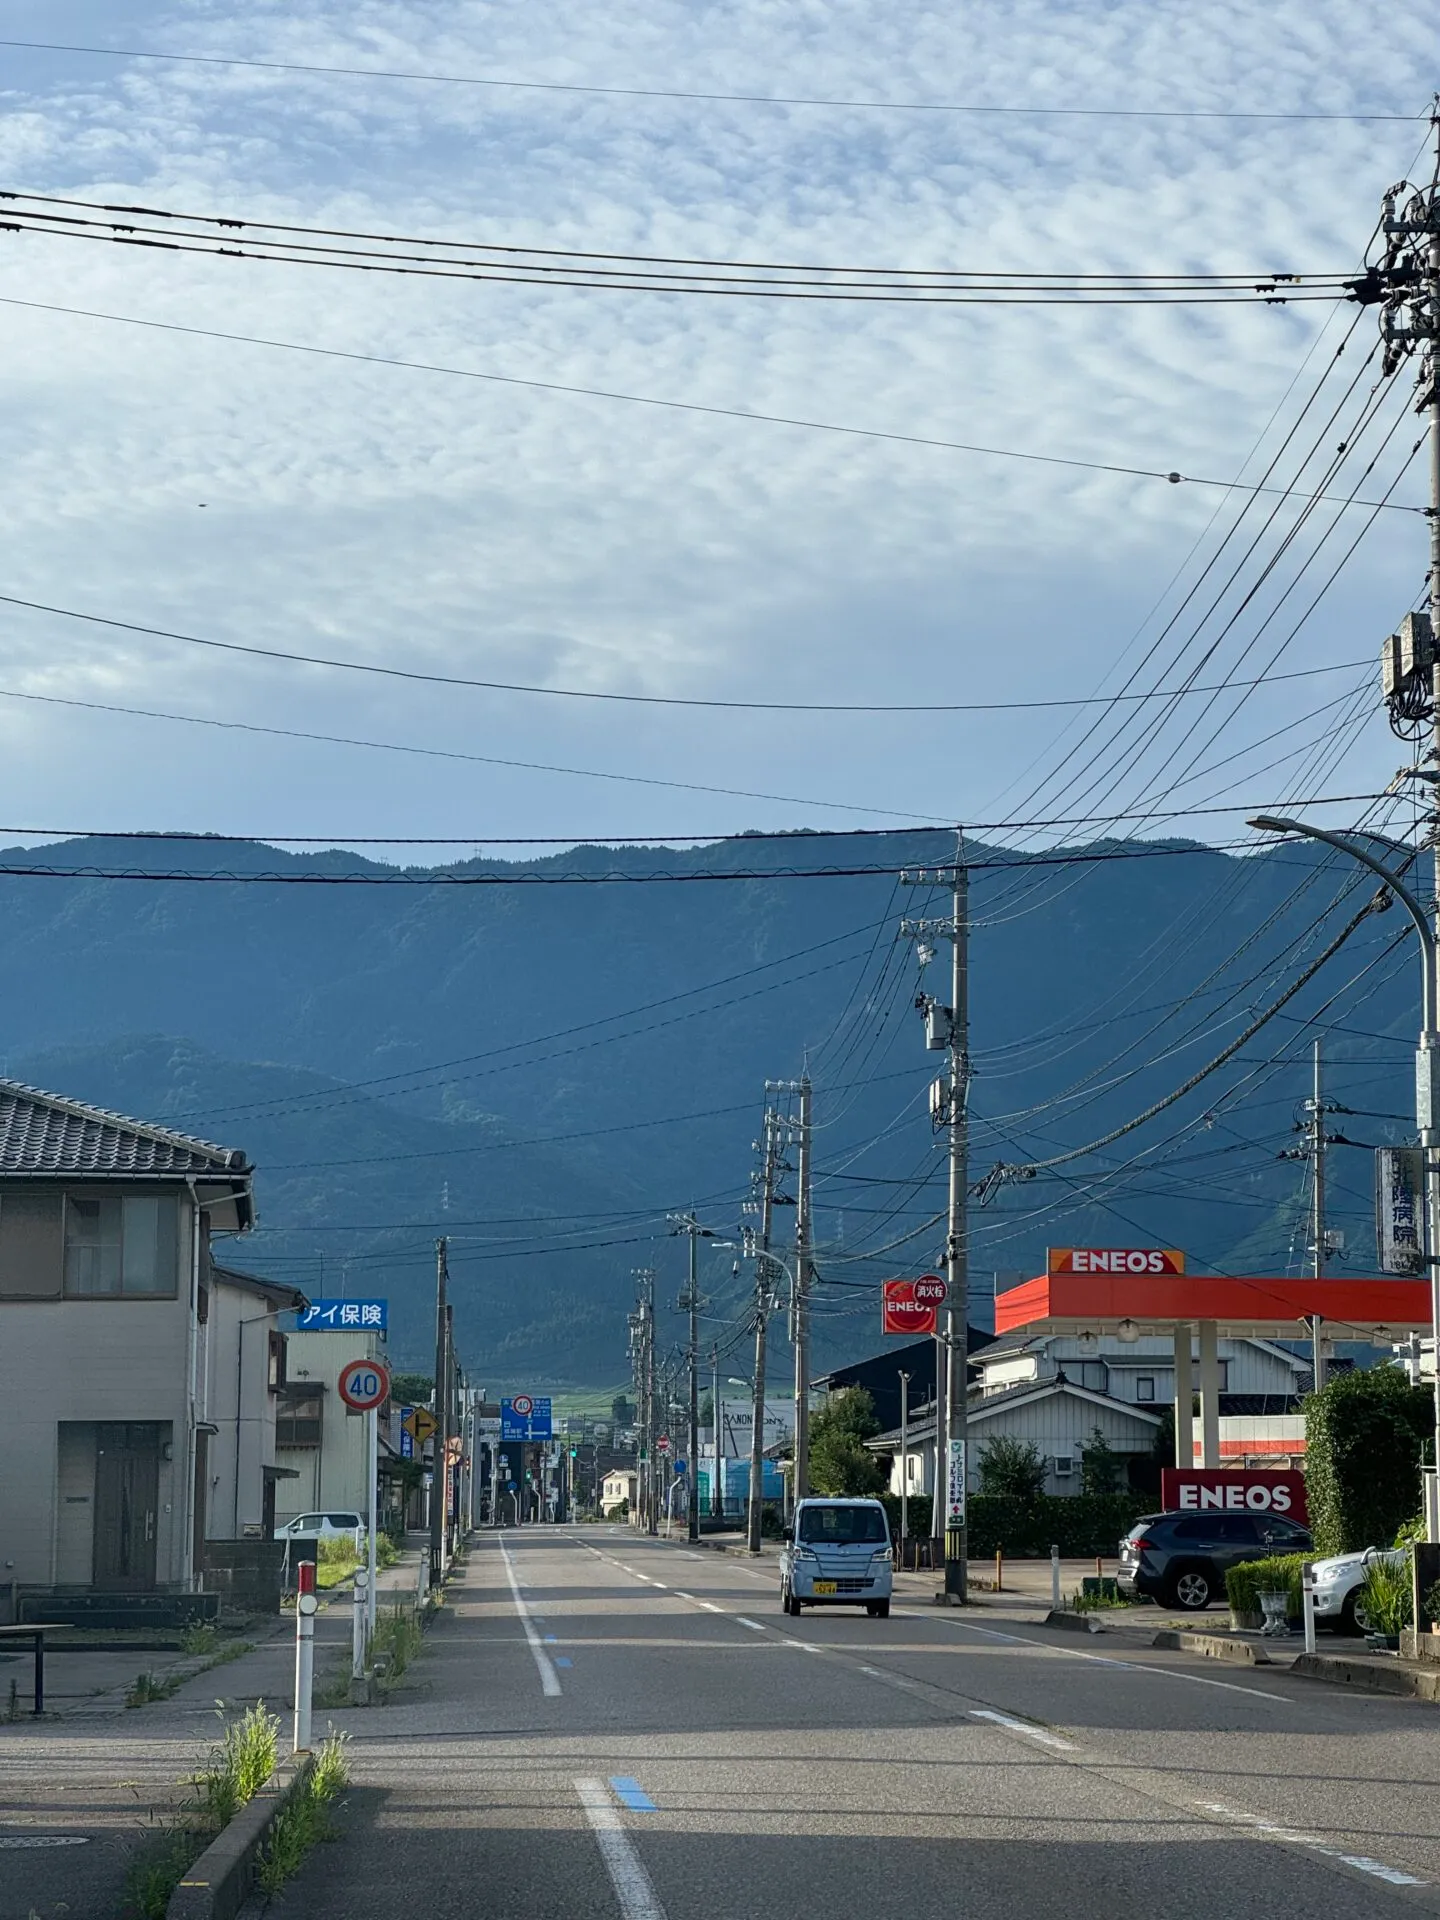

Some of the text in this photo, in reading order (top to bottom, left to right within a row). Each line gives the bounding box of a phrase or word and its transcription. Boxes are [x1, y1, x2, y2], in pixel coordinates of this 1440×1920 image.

[1072, 1251, 1164, 1272] ENEOS
[917, 1285, 944, 1298] 消火栓
[303, 1304, 381, 1325] アイ保険
[350, 1374, 377, 1396] 40
[518, 1401, 529, 1410] 40
[1179, 1485, 1292, 1511] ENEOS
